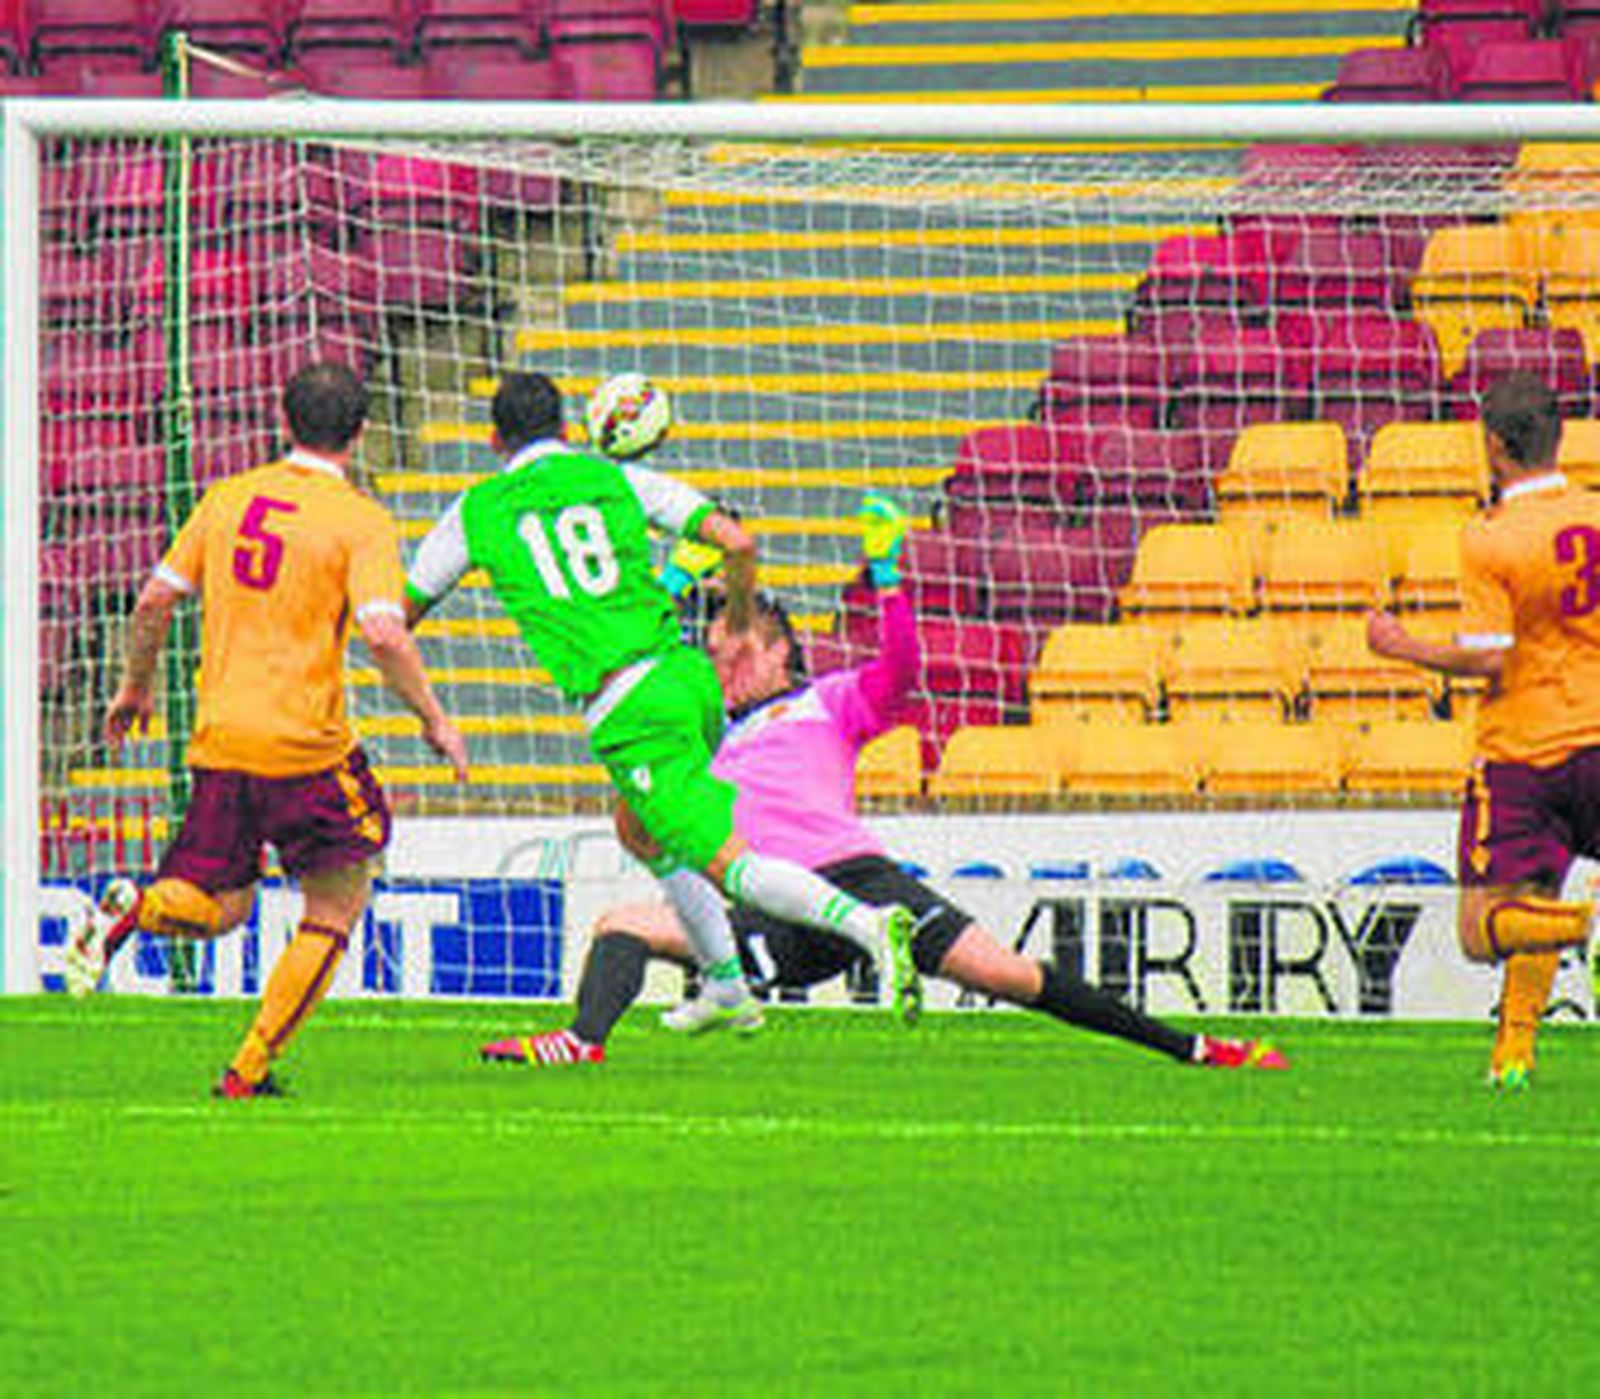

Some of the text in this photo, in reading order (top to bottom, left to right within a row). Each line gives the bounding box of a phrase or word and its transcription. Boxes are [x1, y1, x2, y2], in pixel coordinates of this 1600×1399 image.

[233, 496, 298, 590] 5
[517, 504, 620, 600] 18
[1555, 525, 1600, 617] 3
